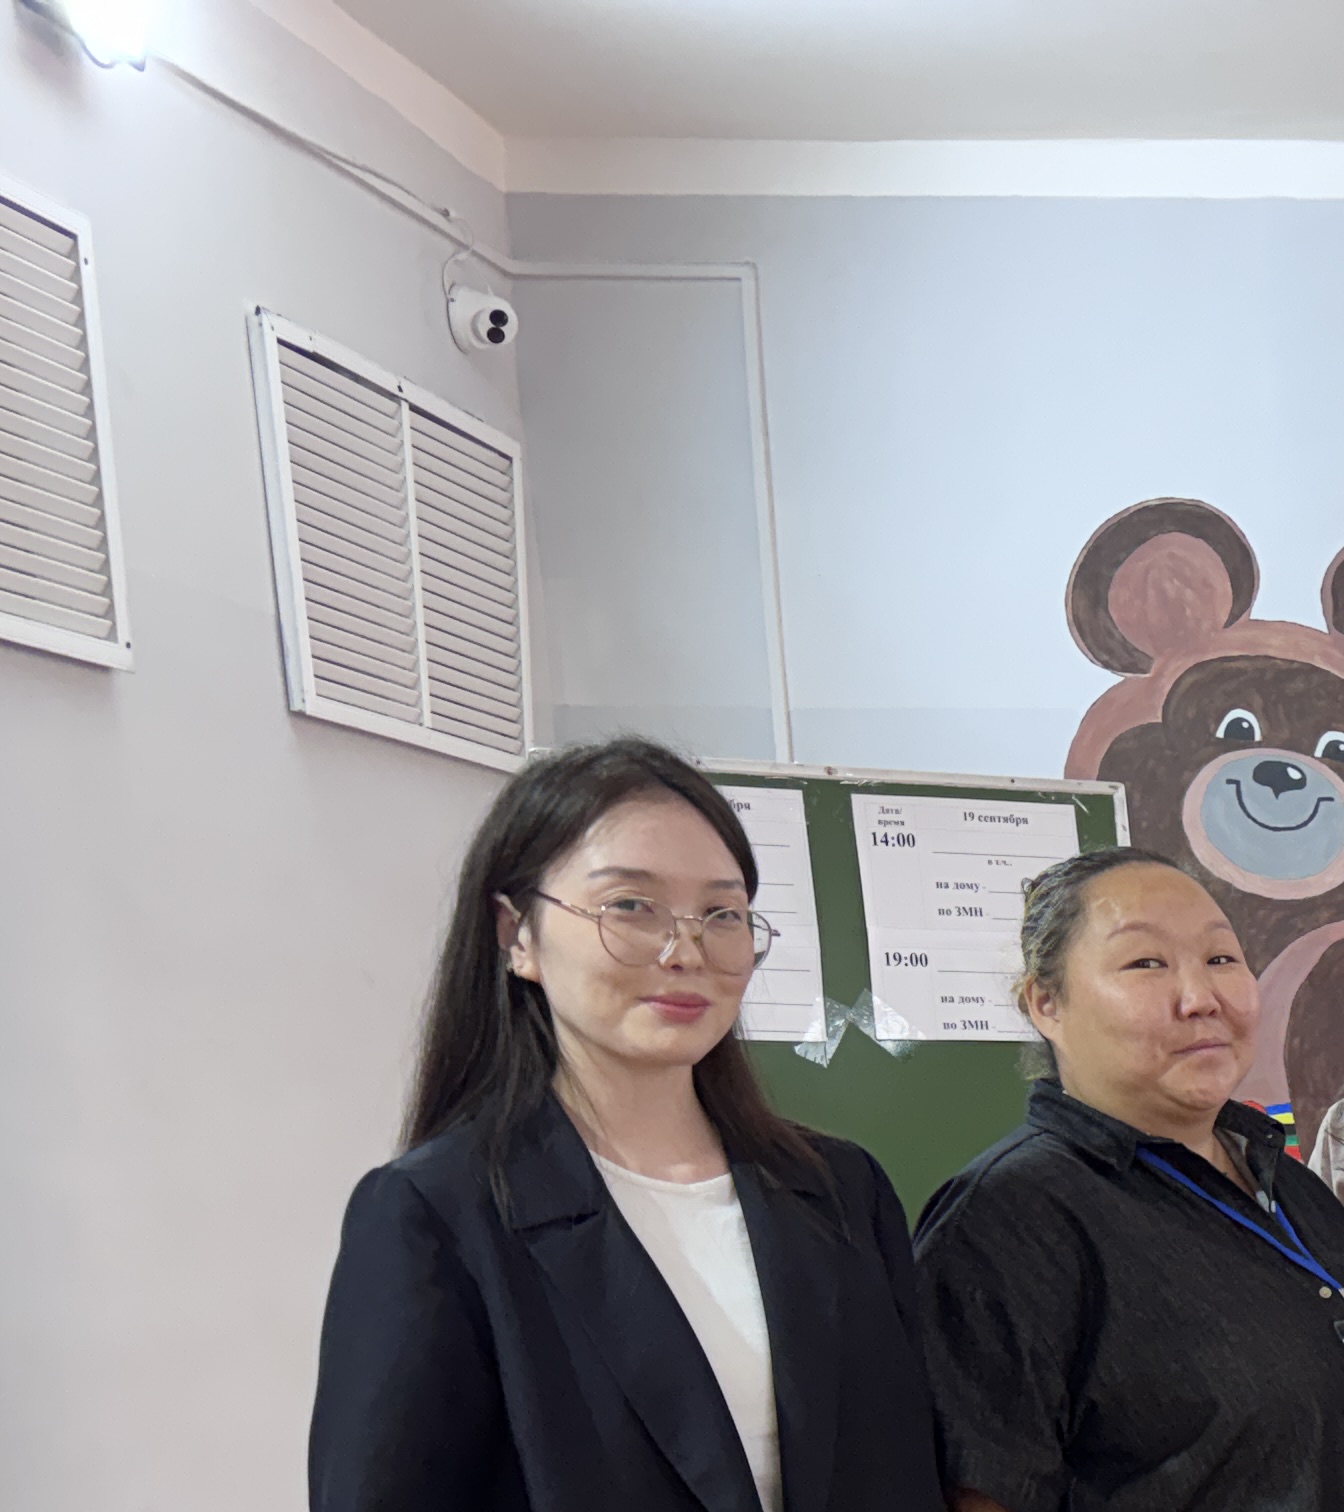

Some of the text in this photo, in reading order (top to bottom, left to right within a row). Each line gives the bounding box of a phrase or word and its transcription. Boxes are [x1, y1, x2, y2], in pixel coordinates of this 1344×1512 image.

[963, 812, 1029, 825] 19 сентября
[871, 832, 916, 848] 14:00
[936, 881, 980, 893] на дому
[938, 908, 952, 917] по
[885, 952, 929, 968] 19:00
[941, 996, 985, 1007] на дому
[943, 1022, 957, 1030] по
